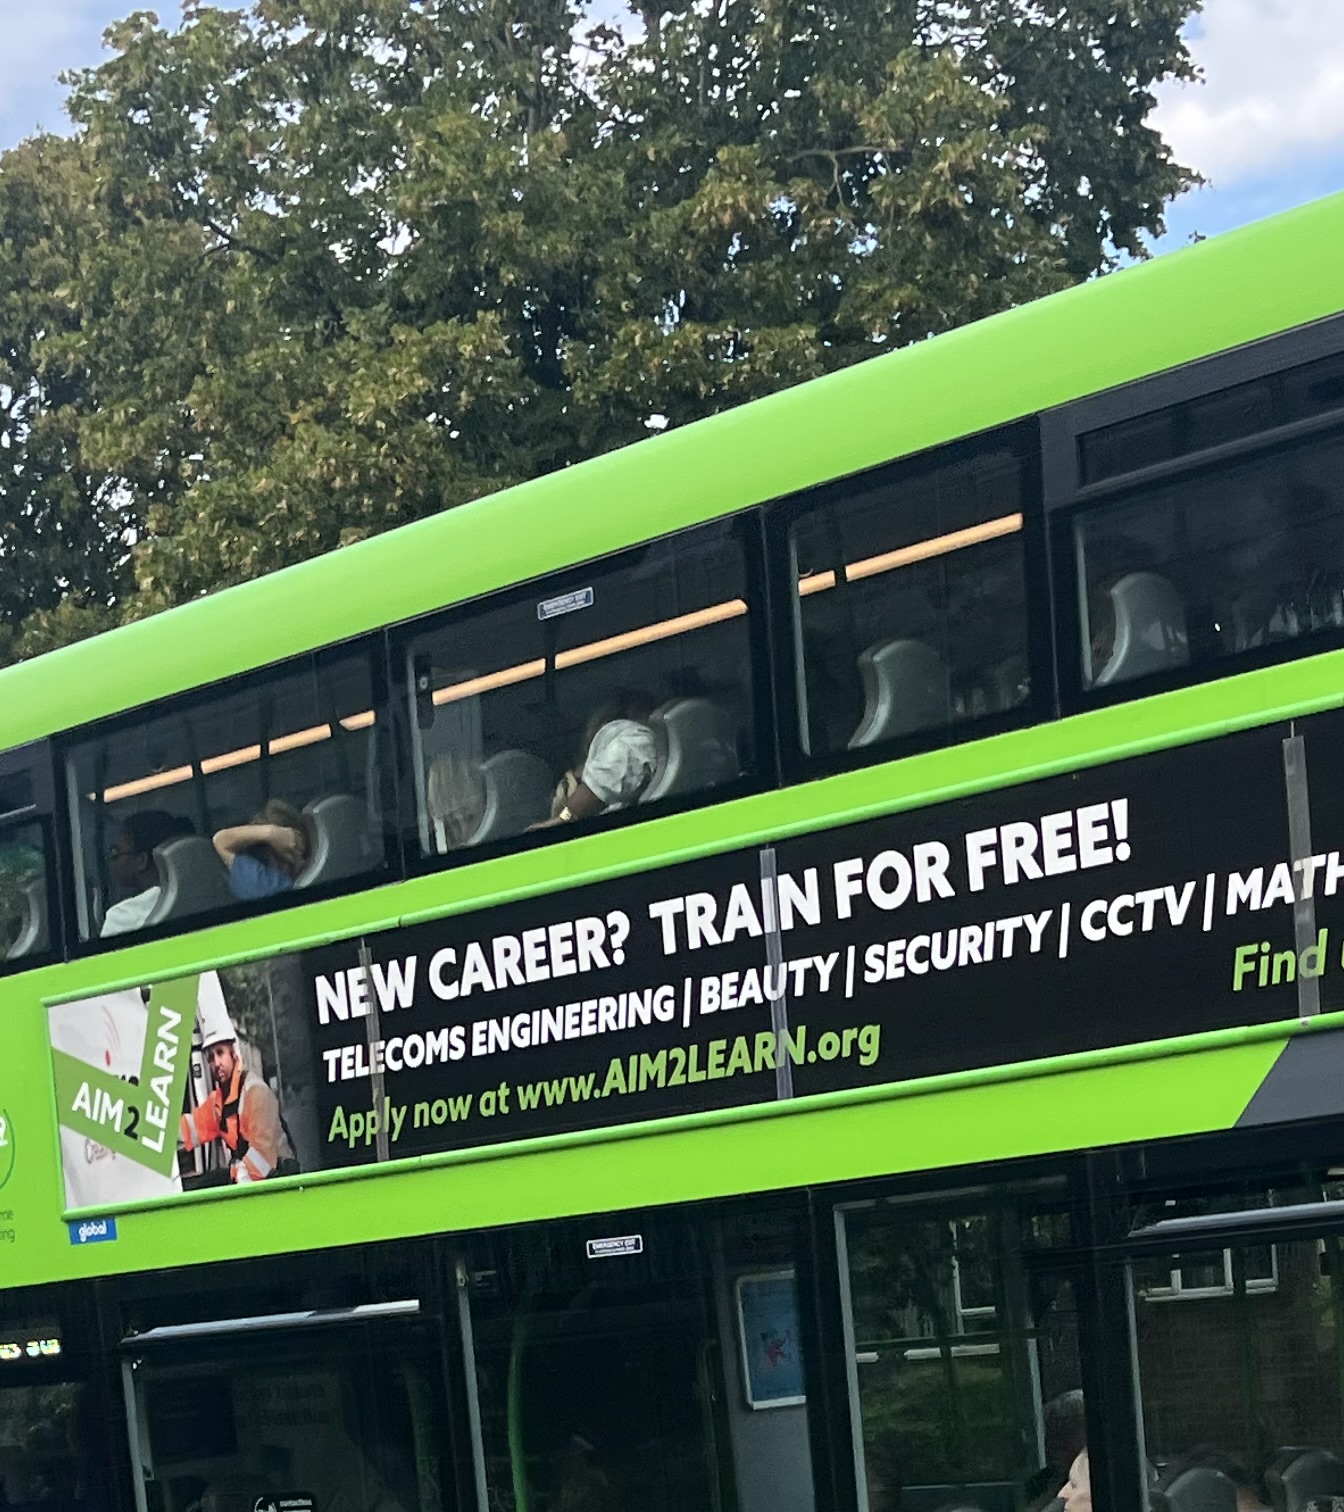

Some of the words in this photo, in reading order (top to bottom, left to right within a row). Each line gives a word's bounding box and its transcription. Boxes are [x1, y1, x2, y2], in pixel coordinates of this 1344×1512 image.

[314, 955, 418, 1025] NEW
[428, 910, 631, 1001] CAREER?
[648, 867, 821, 956] TRAIN
[833, 840, 956, 920] FOR
[965, 797, 1131, 892] FREE!
[1232, 927, 1329, 992] Find
[322, 1025, 466, 1083] TELECOMS
[471, 984, 675, 1057] ENGINEERING
[699, 951, 840, 1015] BEAUTY
[863, 909, 1054, 985] SECURITY
[1080, 880, 1197, 942] CCTV
[71, 1081, 125, 1133] AIM
[141, 1006, 182, 1153] LEARN
[327, 1096, 408, 1149] Apply
[413, 1093, 473, 1129] now
[479, 1081, 511, 1117] at
[516, 1024, 881, 1111] www.AIM2LEARN.org
[78, 1220, 108, 1243] global
